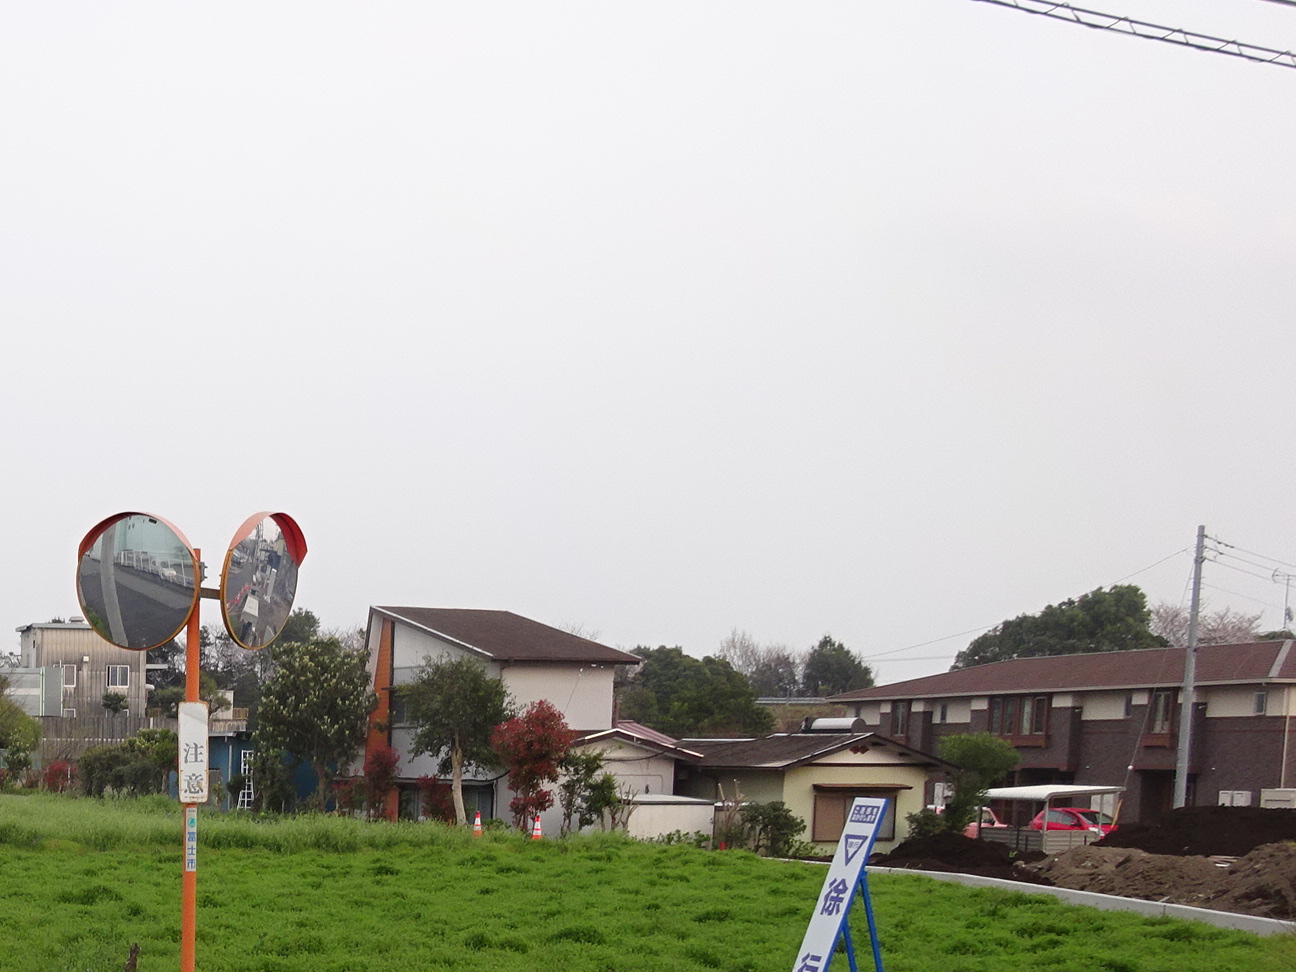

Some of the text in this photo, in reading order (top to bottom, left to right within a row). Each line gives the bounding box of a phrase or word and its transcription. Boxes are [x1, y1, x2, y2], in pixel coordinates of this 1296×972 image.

[184, 742, 204, 795] 注意
[187, 831, 196, 869] 富士市
